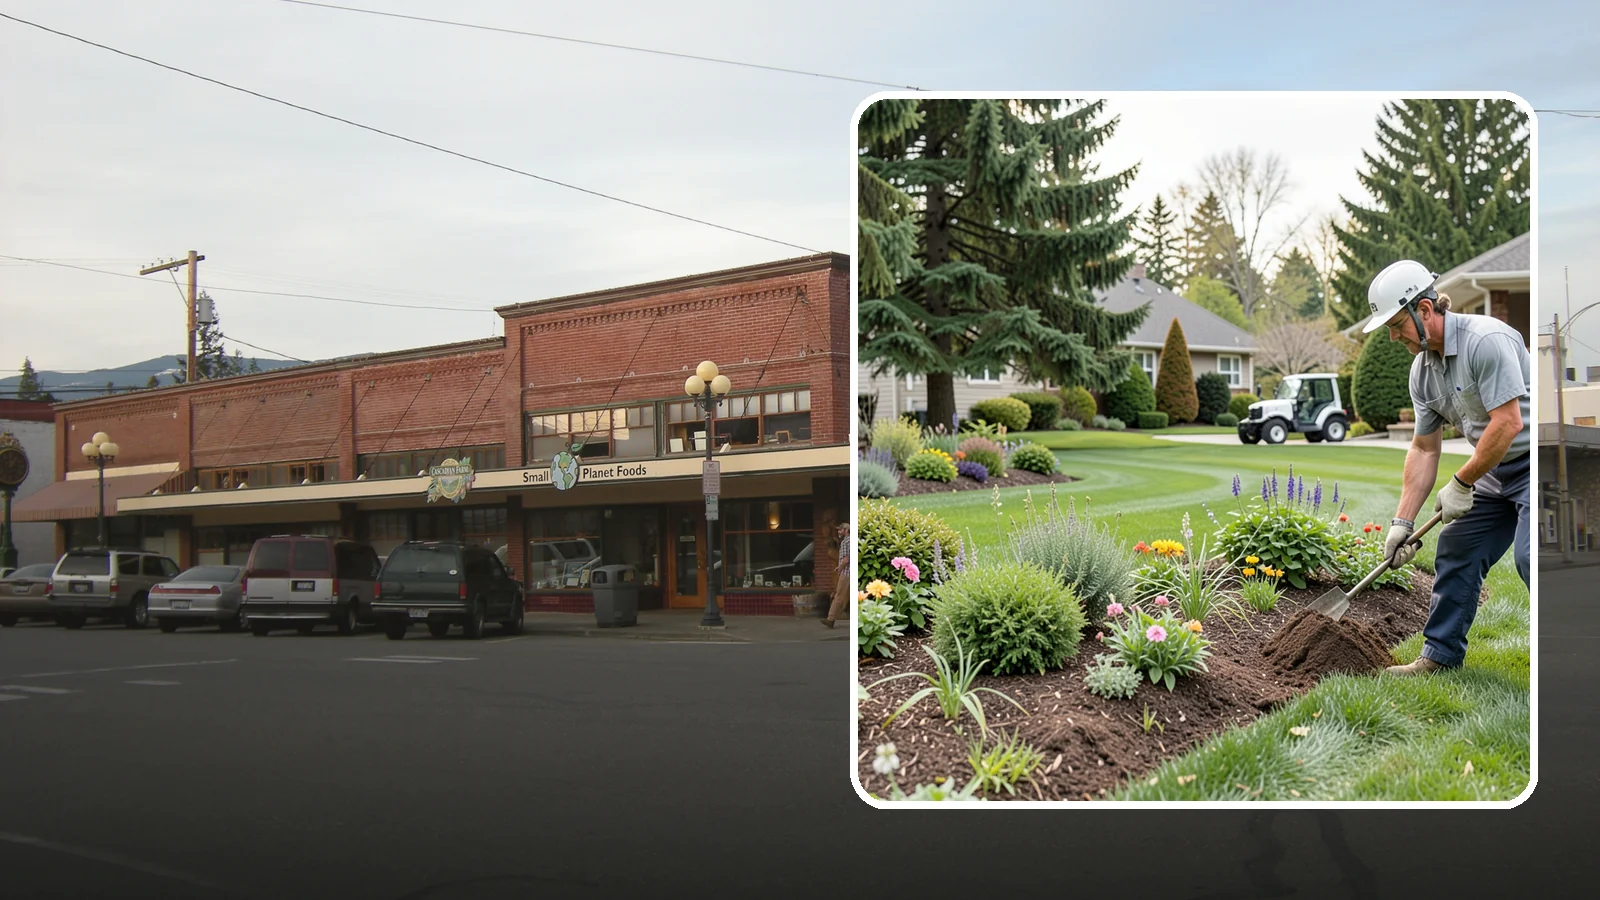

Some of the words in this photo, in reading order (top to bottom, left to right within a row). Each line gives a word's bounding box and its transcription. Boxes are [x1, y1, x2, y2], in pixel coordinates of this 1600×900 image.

[523, 471, 549, 483] Small
[583, 467, 614, 479] Planet
[617, 464, 647, 477] Foods
